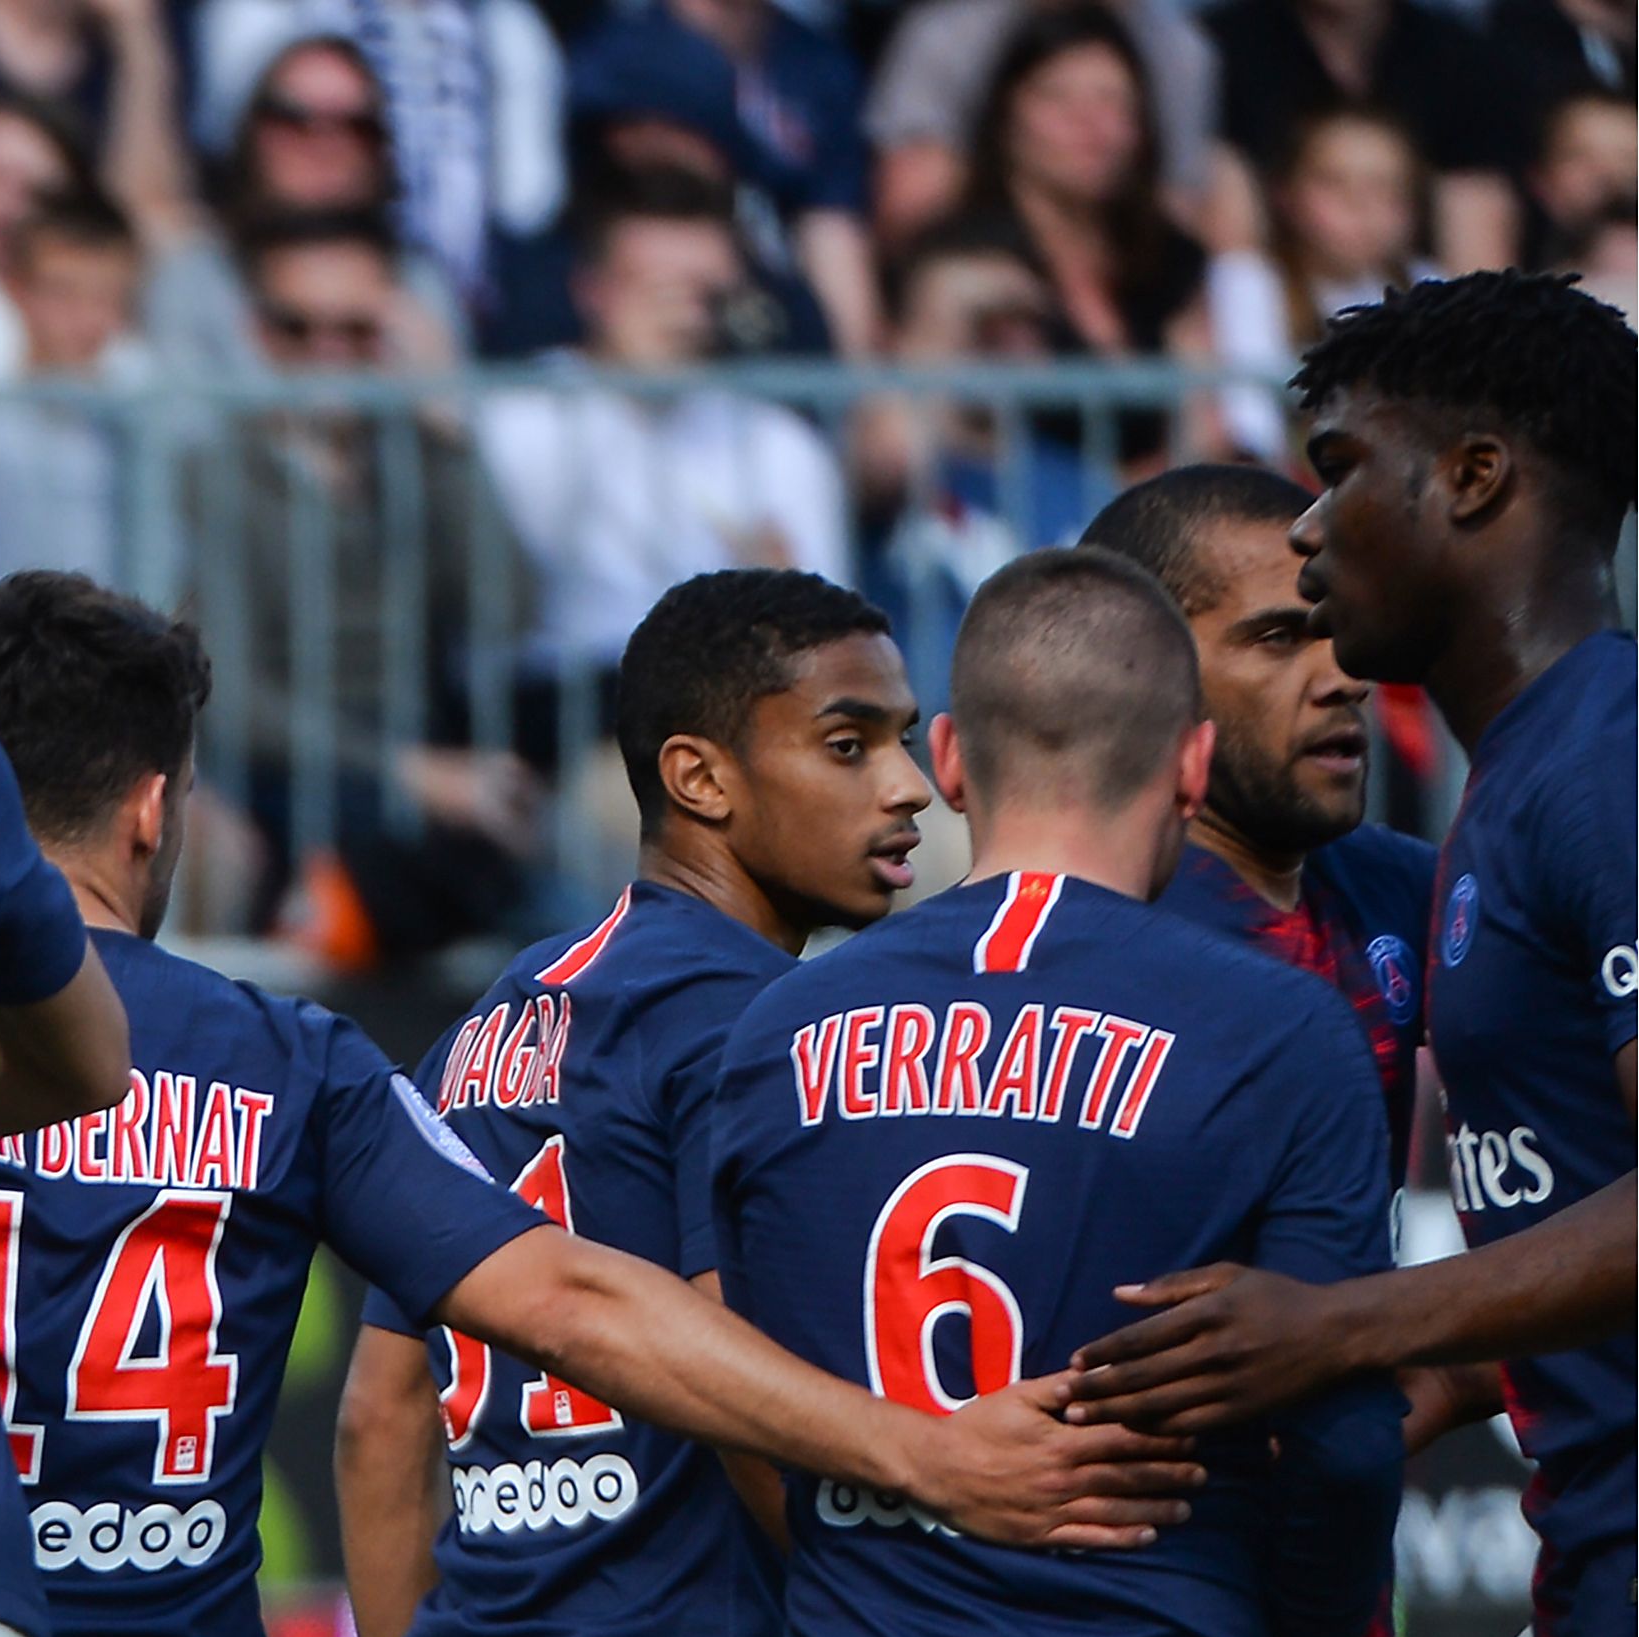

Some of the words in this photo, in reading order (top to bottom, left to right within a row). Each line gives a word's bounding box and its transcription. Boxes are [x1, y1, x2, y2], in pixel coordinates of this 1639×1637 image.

[792, 1000, 1174, 1138] VERRATTI
[864, 1153, 1029, 1418] 6
[29, 1499, 227, 1573] edoo
